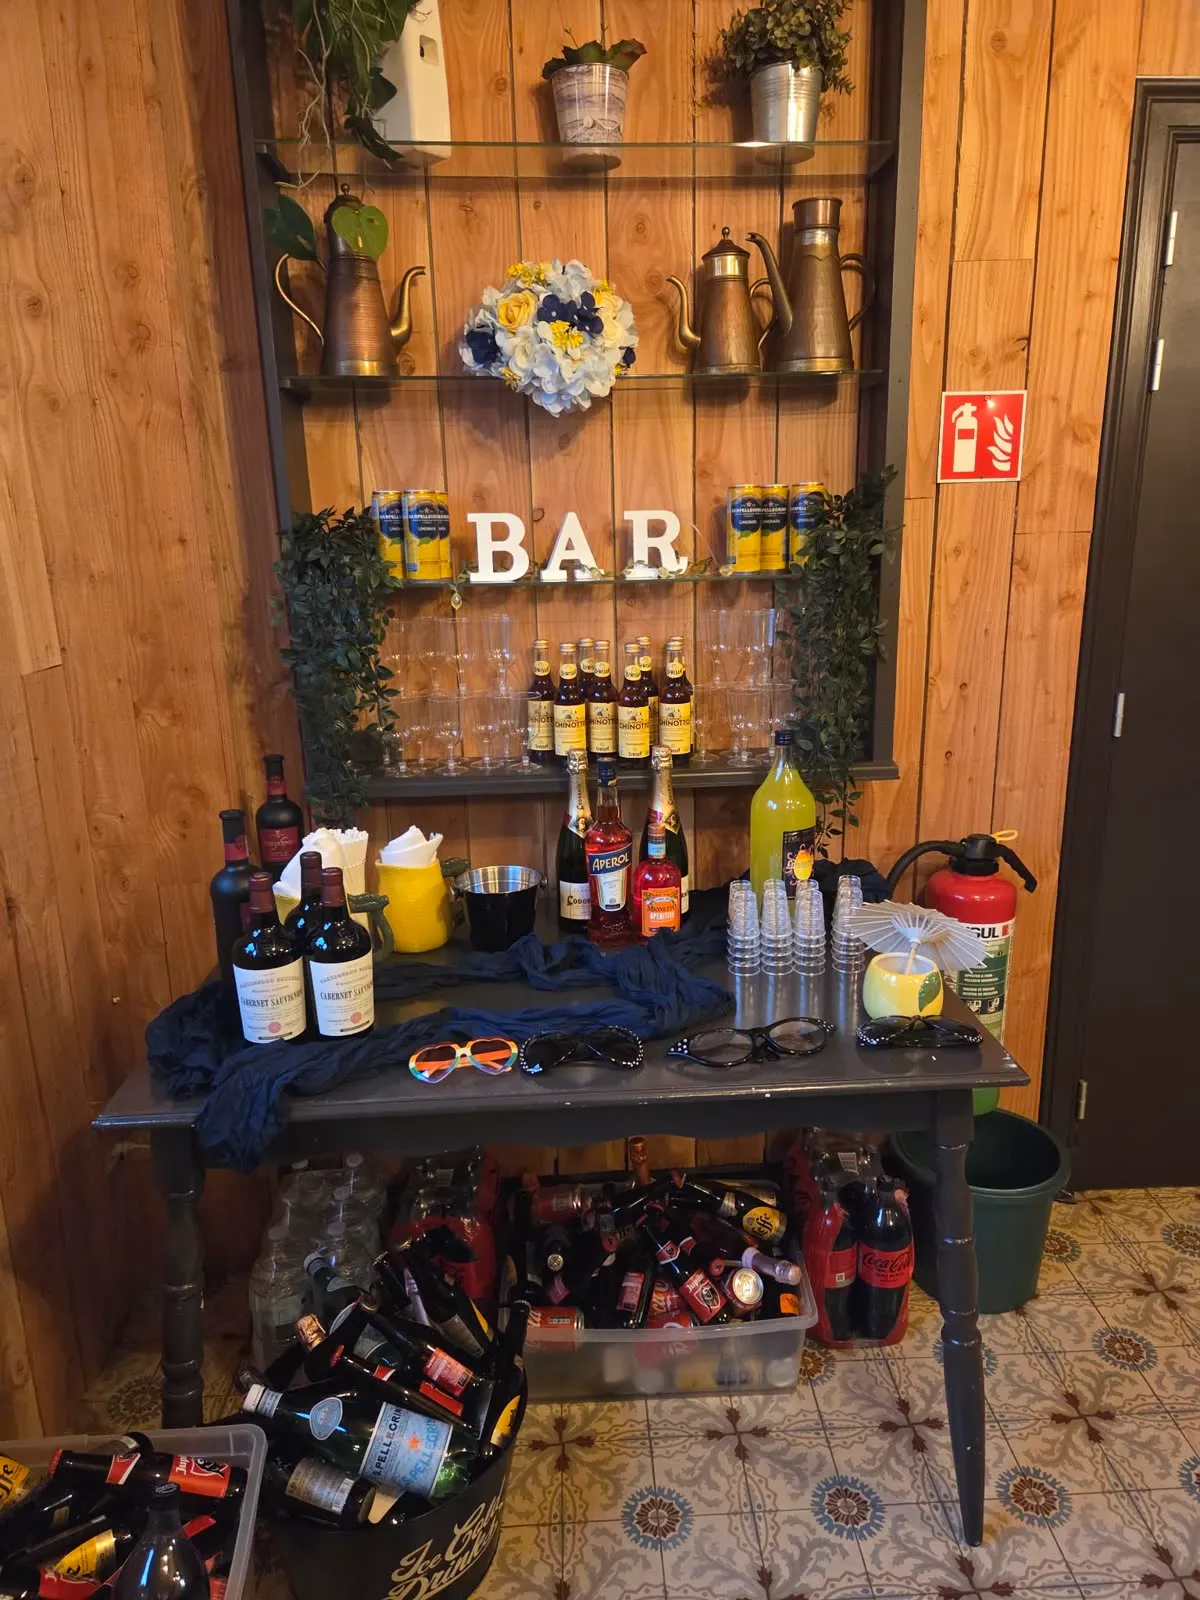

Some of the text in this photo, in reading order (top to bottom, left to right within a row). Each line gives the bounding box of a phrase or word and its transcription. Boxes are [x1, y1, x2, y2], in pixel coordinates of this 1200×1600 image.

[467, 509, 689, 582] BAR
[592, 854, 629, 872] APEROL
[240, 996, 270, 1008] CABERNET
[320, 991, 353, 1000] CABERNET
[373, 1408, 403, 1477] S.PELLEGRIN
[402, 1416, 438, 1489] S.PELLEGRIN
[391, 1482, 504, 1582] Ice Cold
